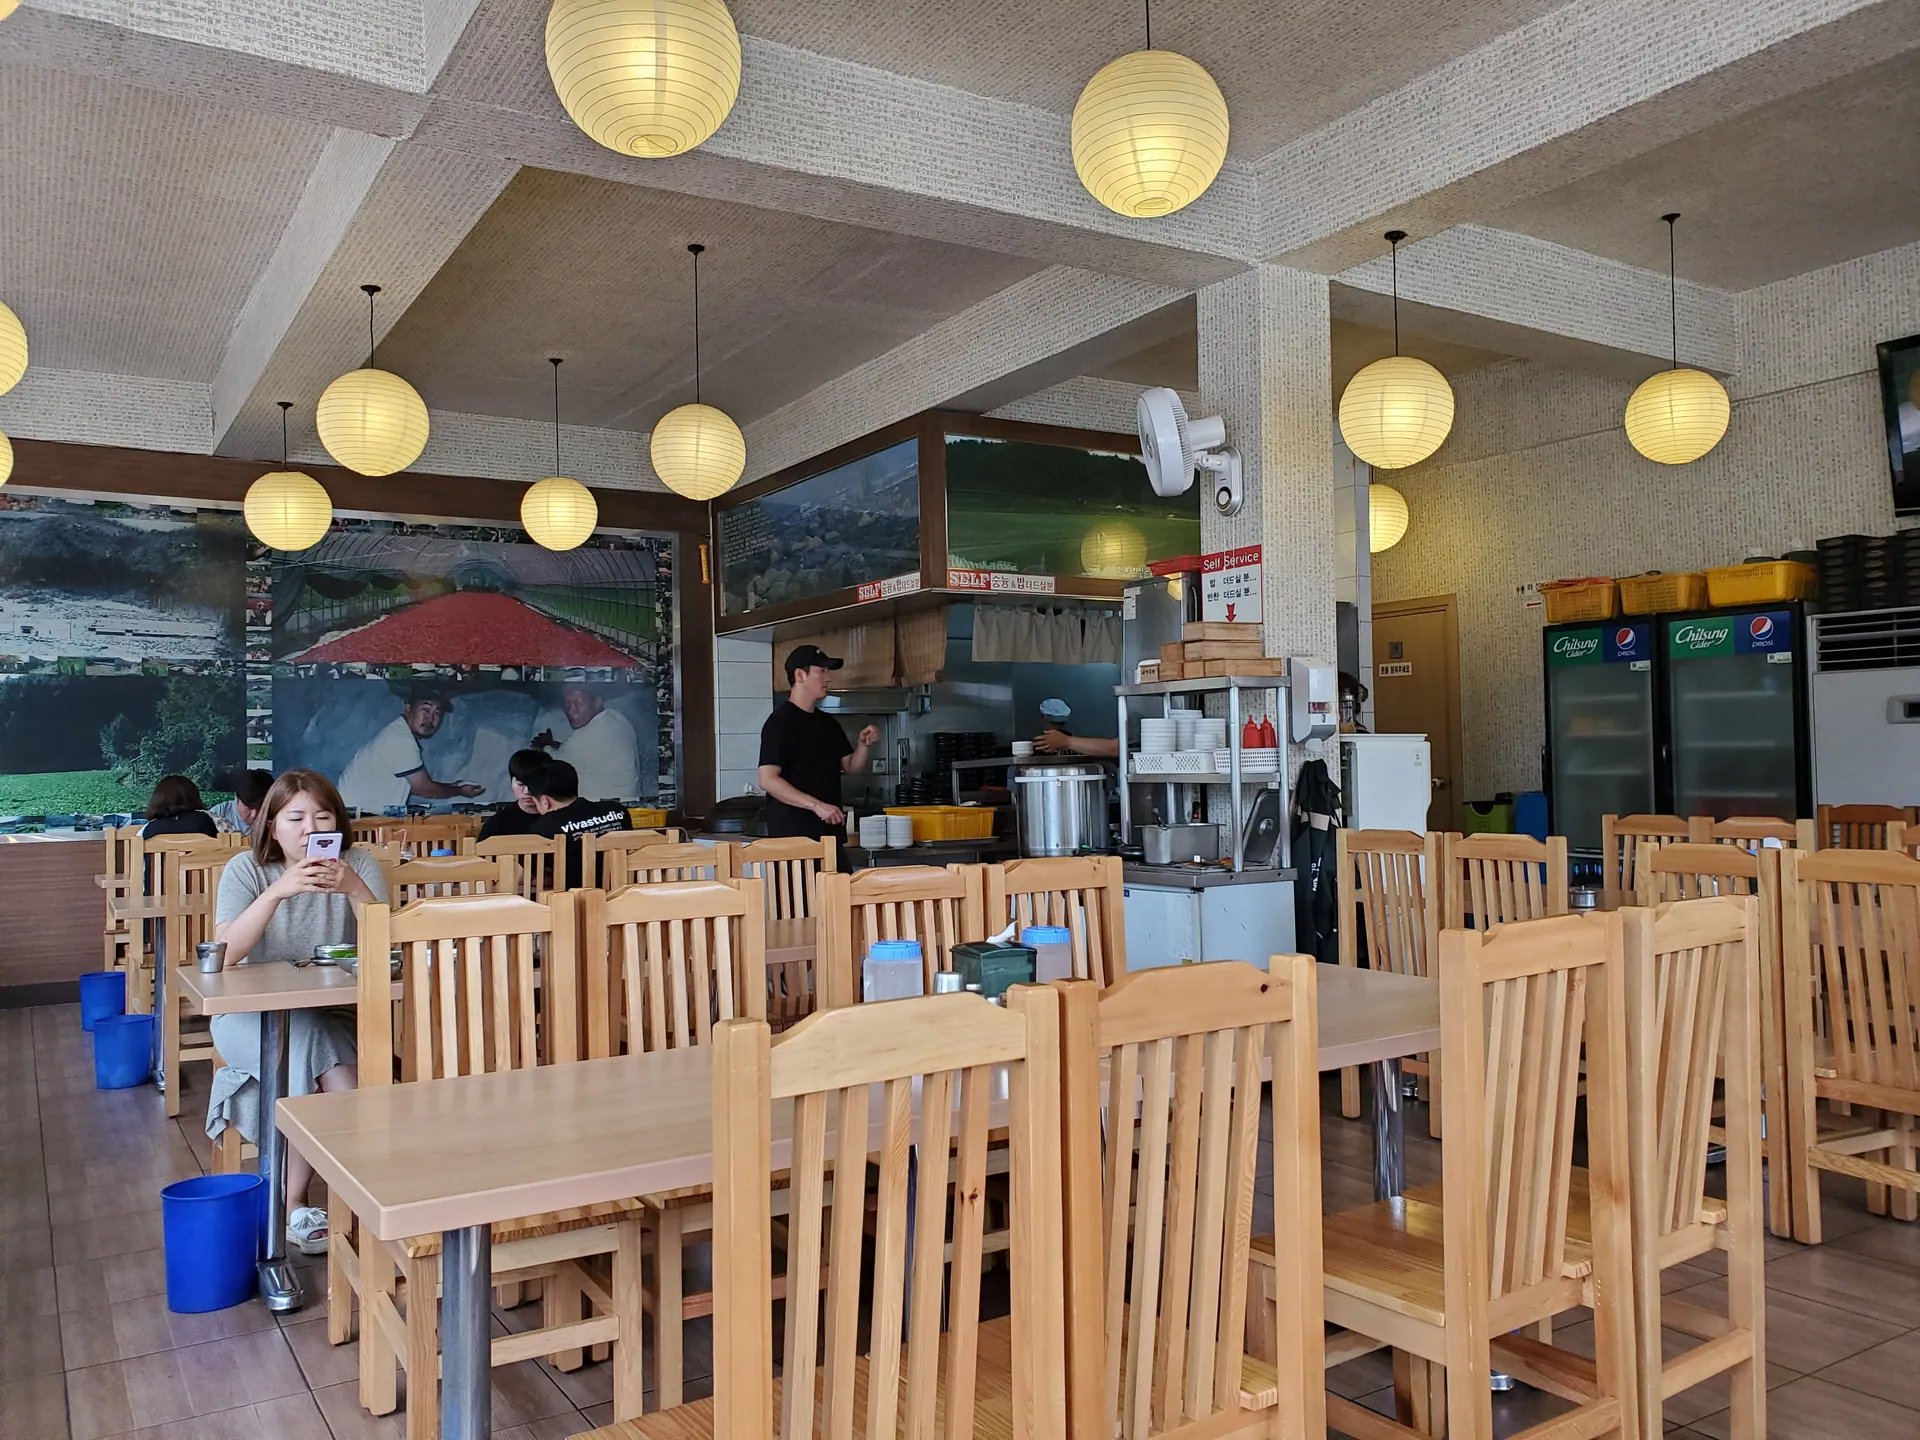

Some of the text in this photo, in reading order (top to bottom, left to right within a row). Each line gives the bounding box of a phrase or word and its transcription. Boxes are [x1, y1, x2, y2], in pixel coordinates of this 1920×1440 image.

[1203, 552, 1259, 571] Self Service
[949, 571, 990, 588] SELF
[1209, 578, 1216, 588] 밥
[858, 582, 881, 601] SELF
[1207, 592, 1220, 603] 반찬
[1674, 625, 1729, 645] Chilsung
[1553, 636, 1599, 654] Chilsung
[1690, 639, 1715, 650] Cider
[1752, 640, 1774, 648] pepsi
[1566, 649, 1588, 658] Cider
[1617, 649, 1636, 657] pepsi
[560, 811, 624, 833] vivastudio
